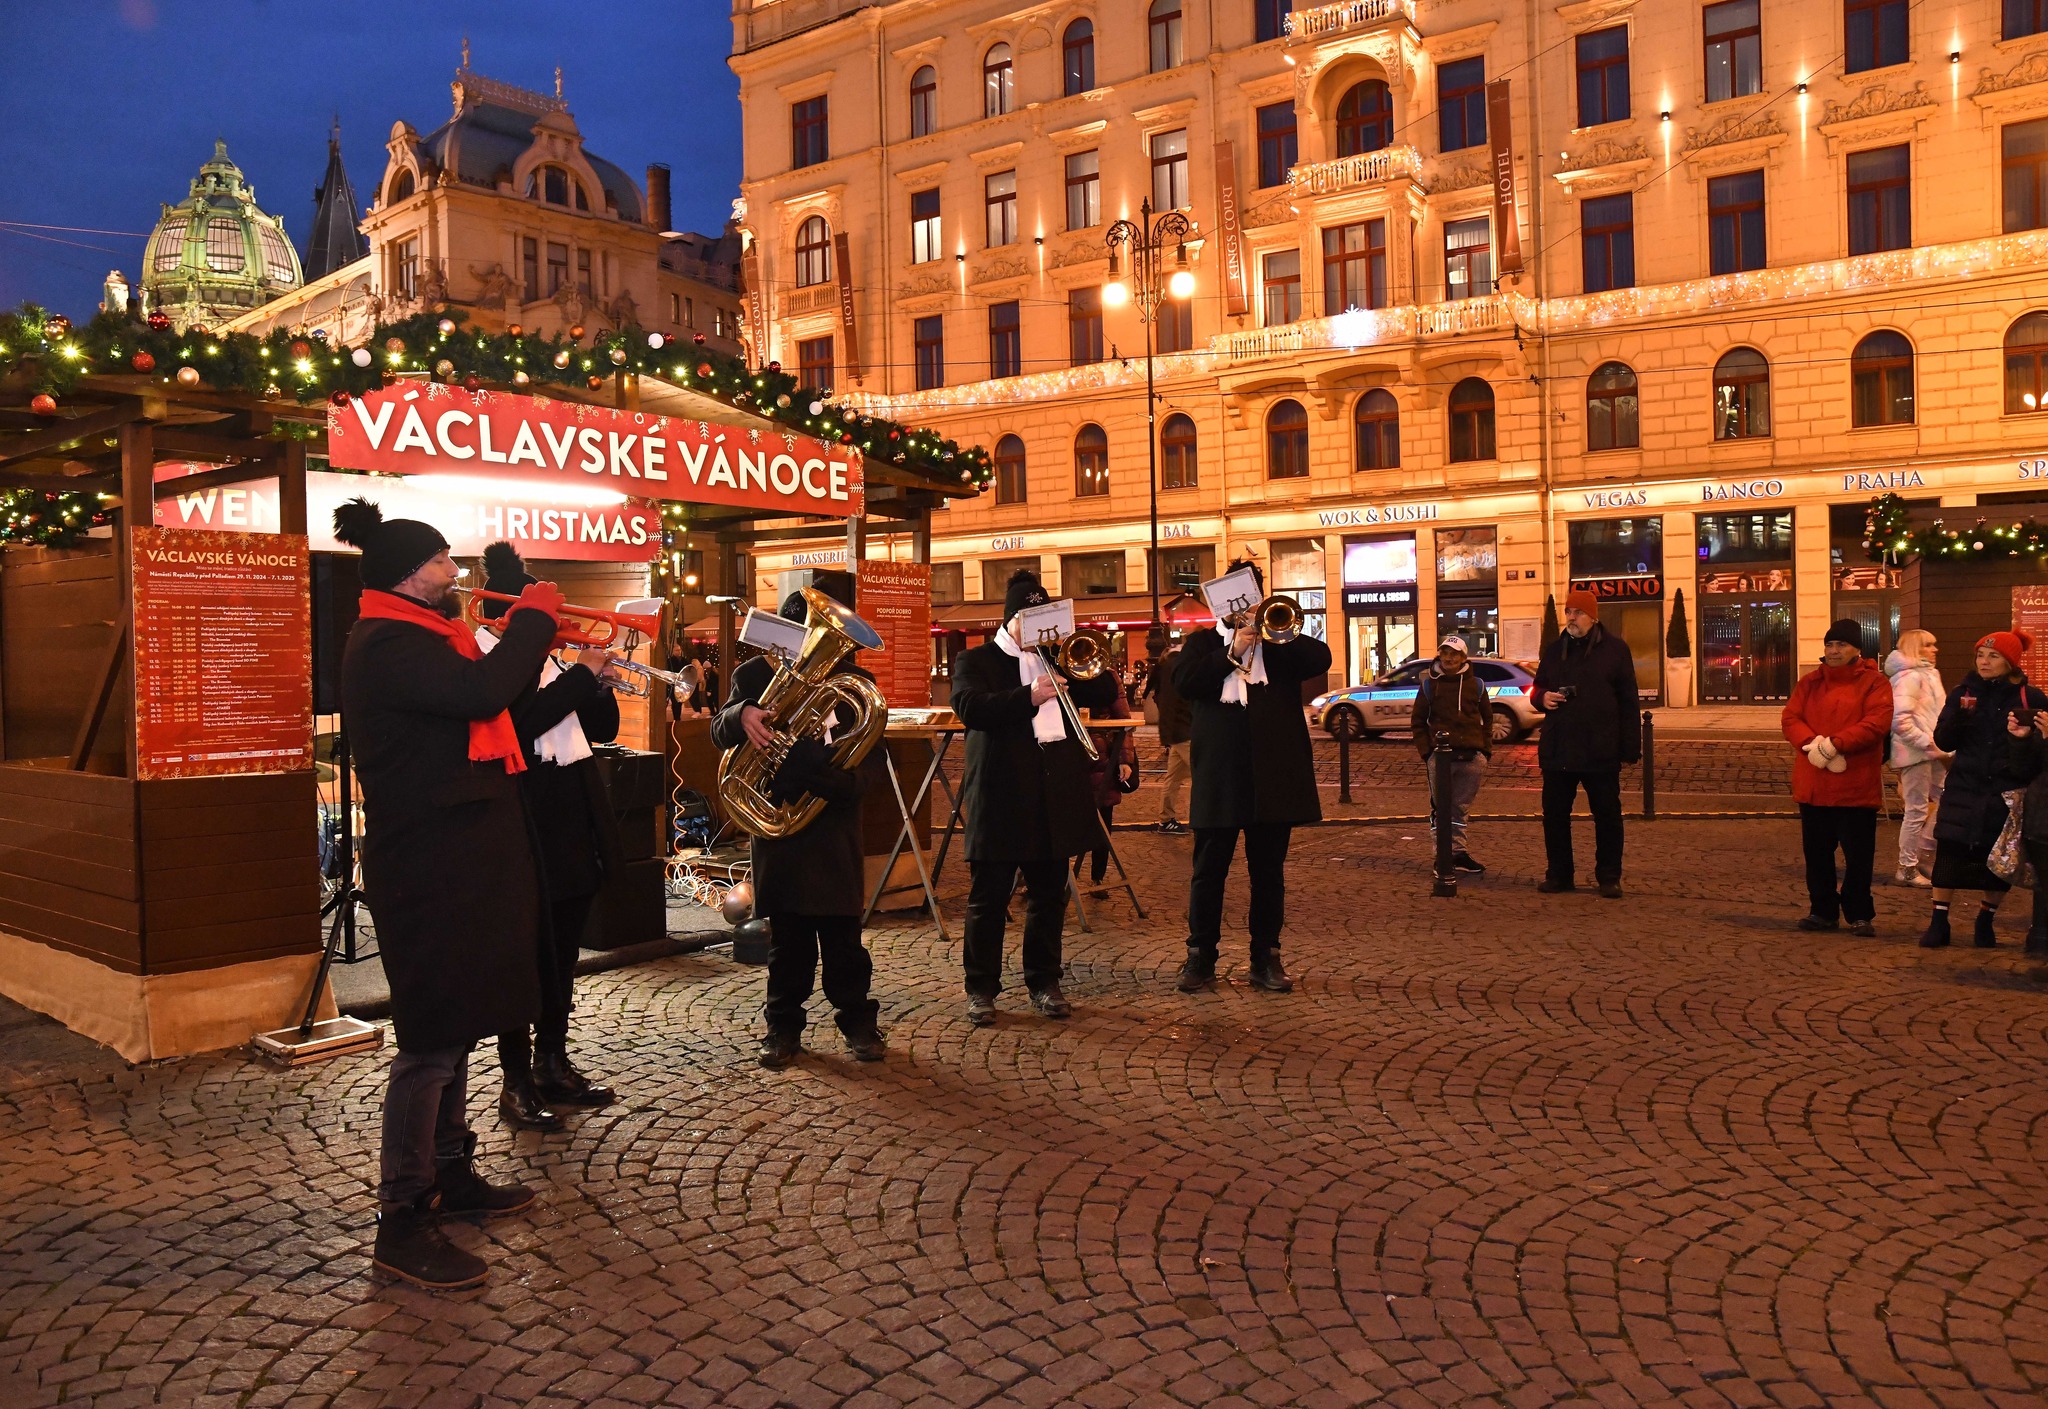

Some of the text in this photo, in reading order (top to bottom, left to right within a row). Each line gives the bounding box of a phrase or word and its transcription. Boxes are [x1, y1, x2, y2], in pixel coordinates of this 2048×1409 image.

[1497, 148, 1512, 206] HOTEL
[1222, 185, 1240, 280] KINGS COURT
[842, 283, 853, 326] HOTEL
[751, 290, 765, 361] INGS COURT
[352, 389, 849, 501] VÁCLAVSKÉ VÁNOCE
[2018, 460, 2048, 479] SP
[1702, 480, 1783, 501] BANCO
[1843, 470, 1925, 491] PRAHA
[1584, 489, 1647, 508] VEGAS
[456, 504, 647, 546] CHRISTMAS
[1319, 504, 1438, 526] WOK & SUSHI
[1163, 524, 1192, 539] BAR
[992, 537, 1025, 551] CAFE
[147, 547, 297, 567] VÁCLAVSKÉ VÁNOCE
[792, 550, 847, 566] BRASSERIE
[172, 571, 198, 579] Republiky
[862, 572, 926, 587] VÁCLAVSKÉ VÁNOCE
[1571, 578, 1660, 597] CASINO
[1348, 593, 1360, 603] MY
[1360, 593, 1378, 603] WOK
